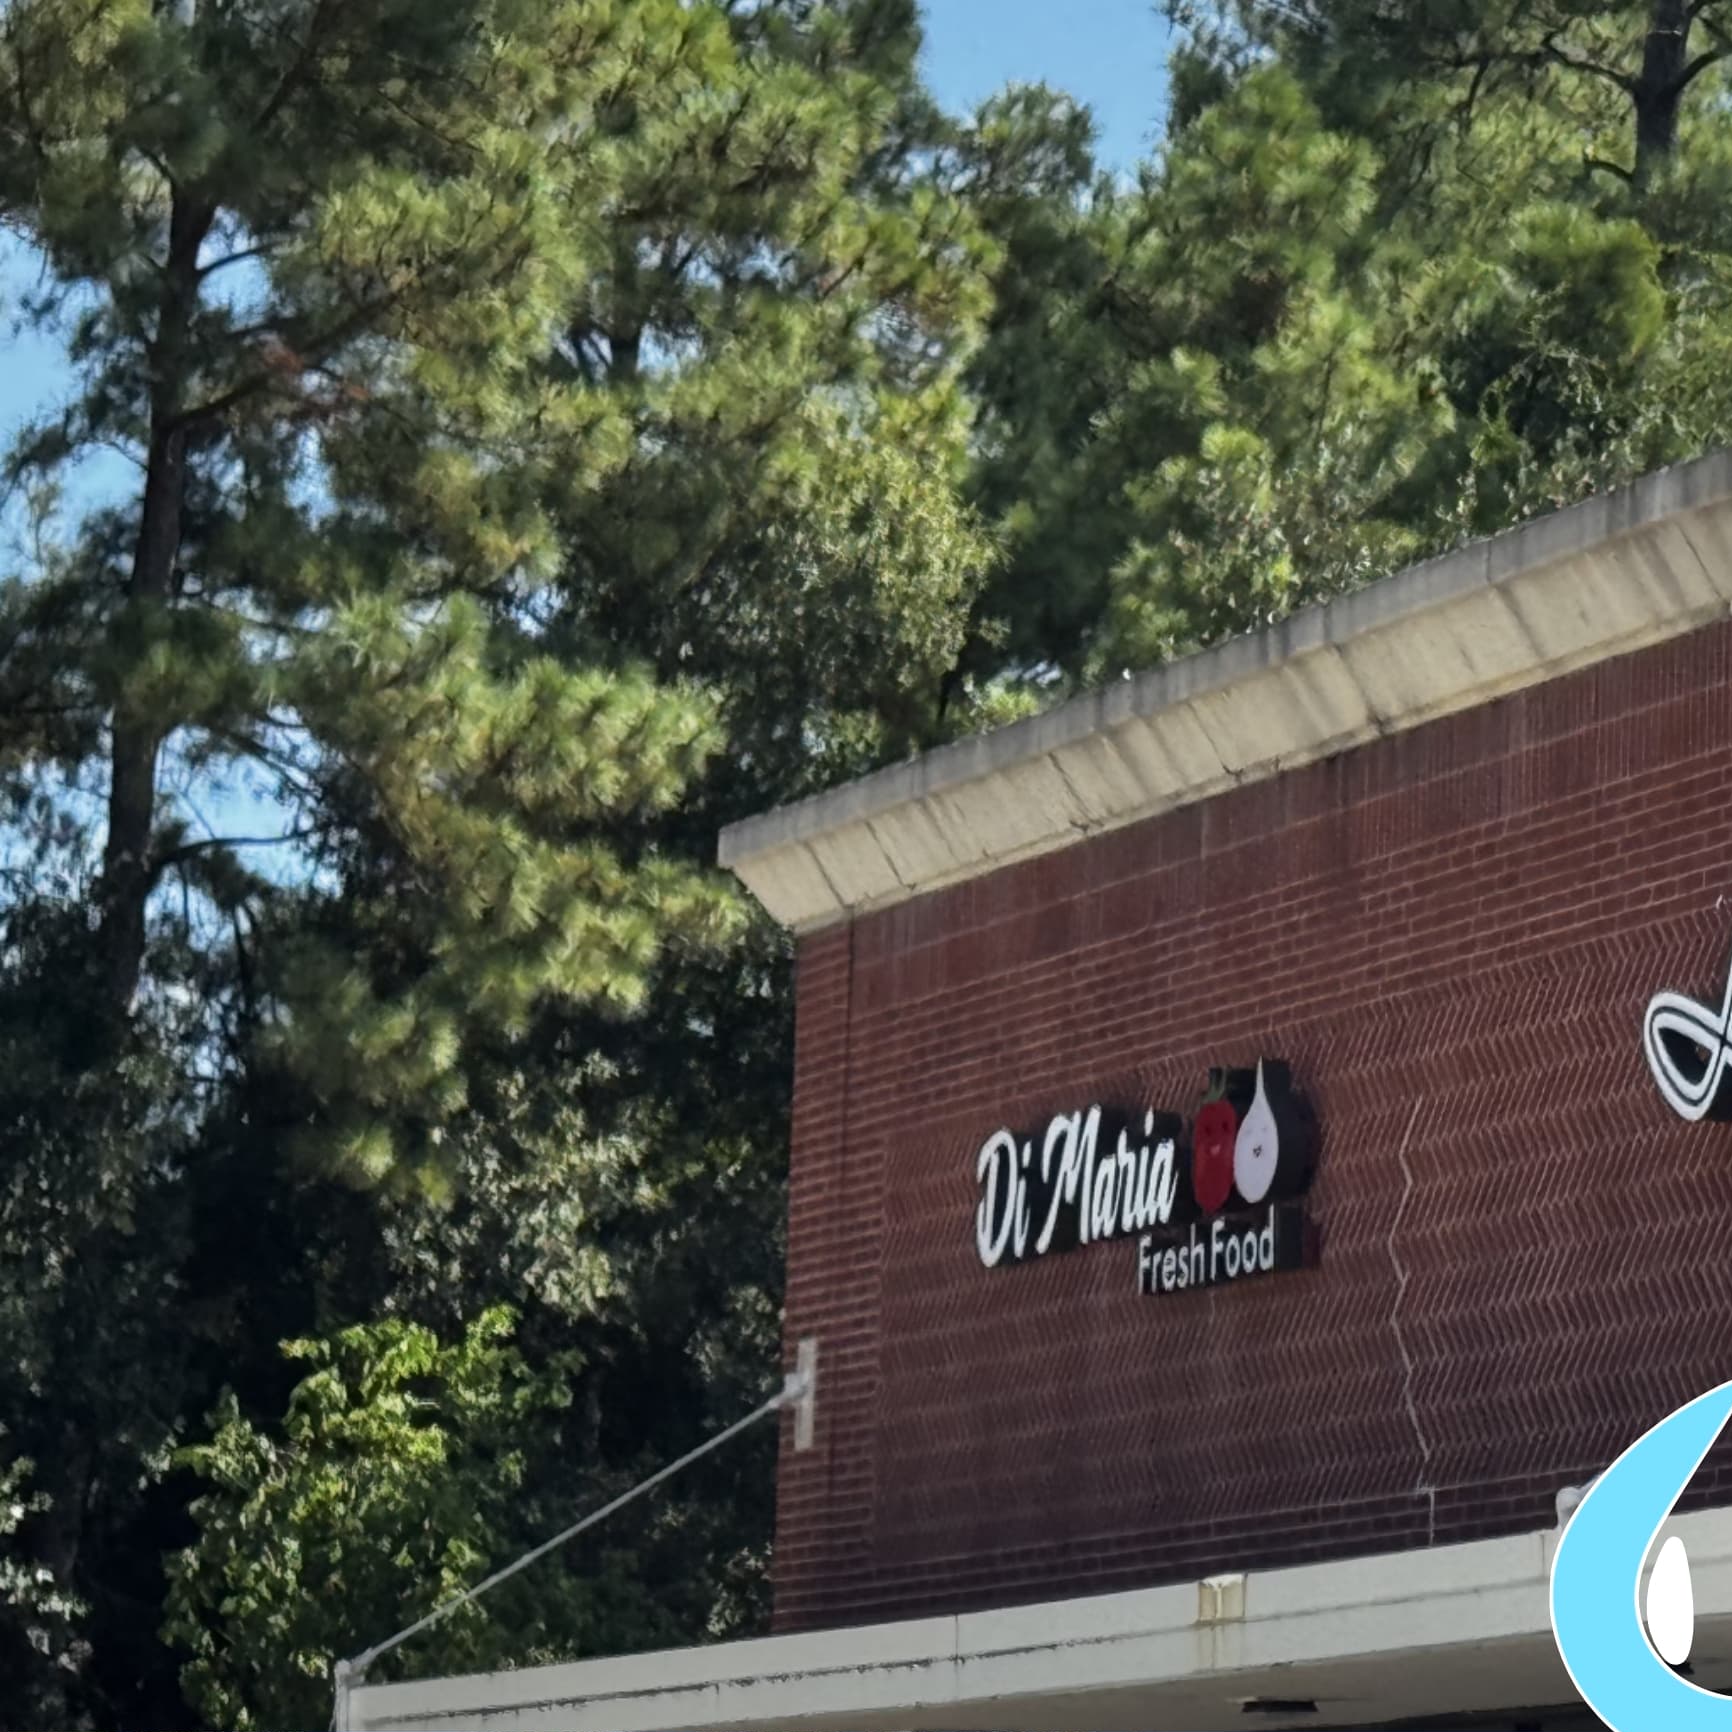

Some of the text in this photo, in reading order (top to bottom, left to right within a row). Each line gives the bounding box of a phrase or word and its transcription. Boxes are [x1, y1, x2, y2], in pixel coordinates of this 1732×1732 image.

[976, 1104, 1178, 1267] Di Maria
[1137, 1203, 1274, 1295] Fresh Food
